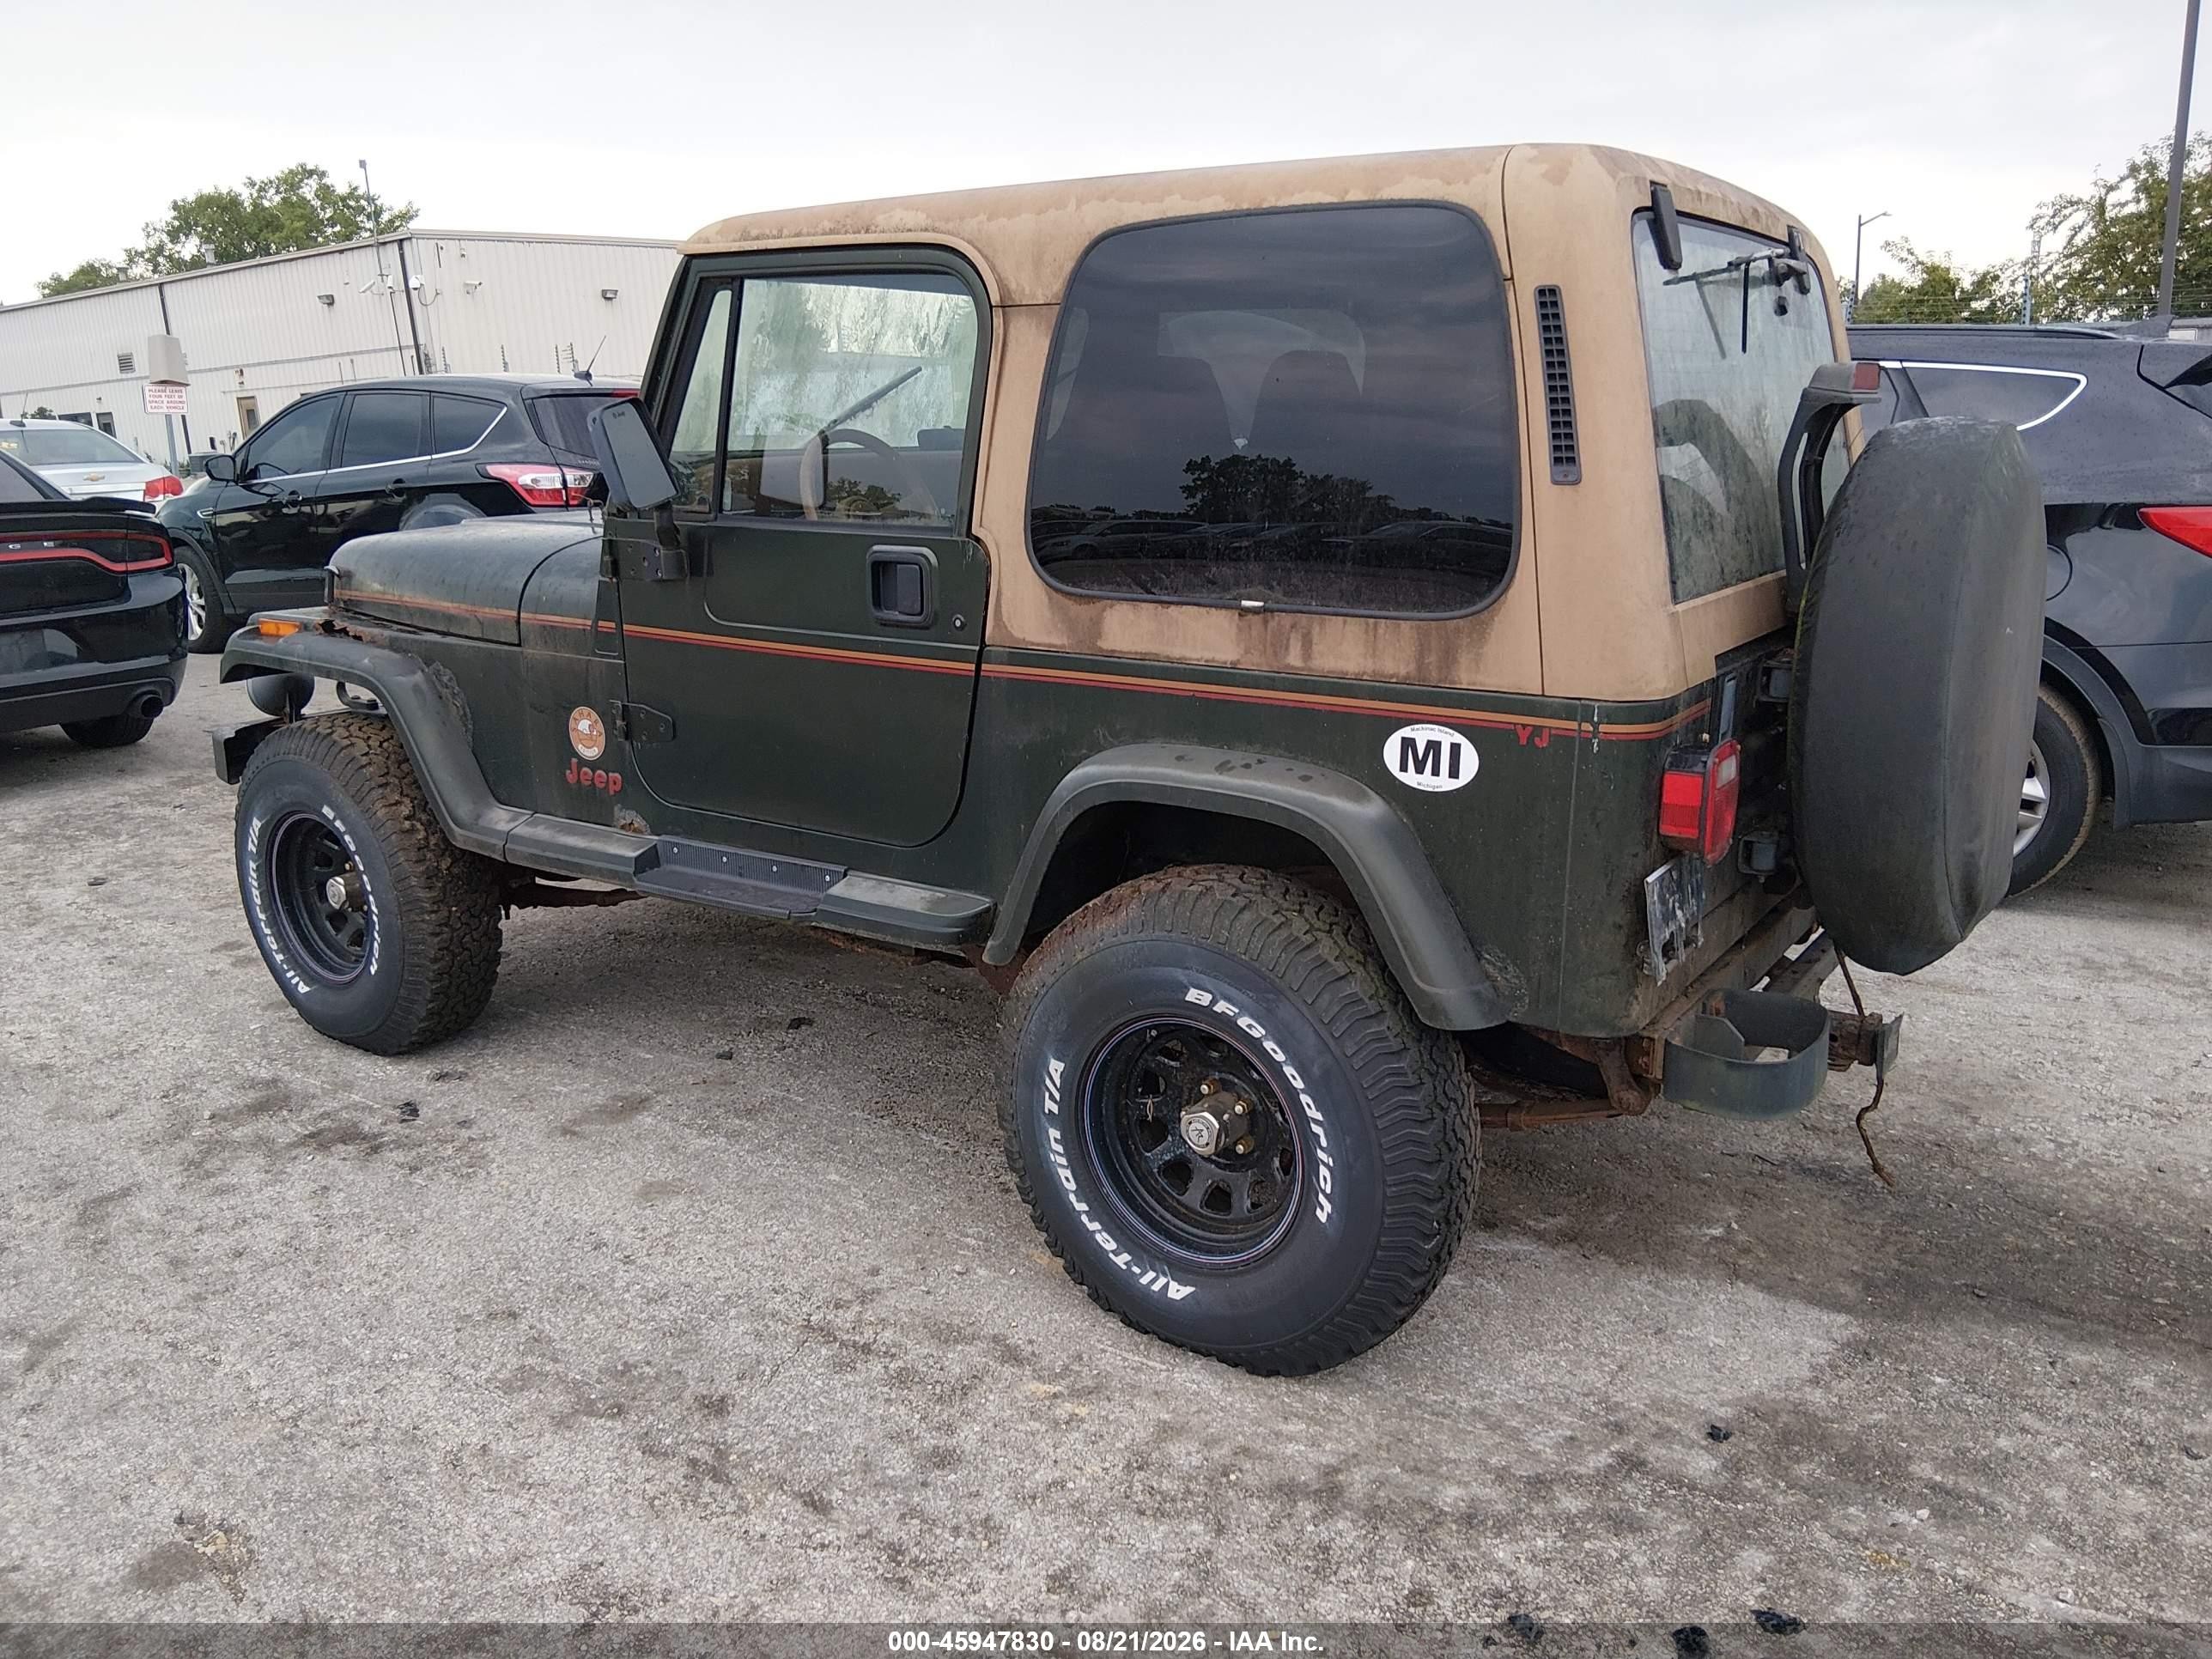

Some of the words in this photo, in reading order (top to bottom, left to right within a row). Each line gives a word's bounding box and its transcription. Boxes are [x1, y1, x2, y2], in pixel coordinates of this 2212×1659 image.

[1437, 727, 1455, 738] Island
[1516, 724, 1549, 748] YJ
[566, 757, 622, 796] Jeep
[1399, 736, 1462, 780] MI
[1416, 781, 1443, 790] Michigan
[247, 817, 262, 854] T/A
[322, 805, 381, 976] BFGoodrich
[248, 860, 312, 994] All-Terrain
[1044, 1058, 1066, 1115] T/A
[1184, 988, 1334, 1224] BFGoodrich
[1048, 1127, 1196, 1301] All-Terrain
